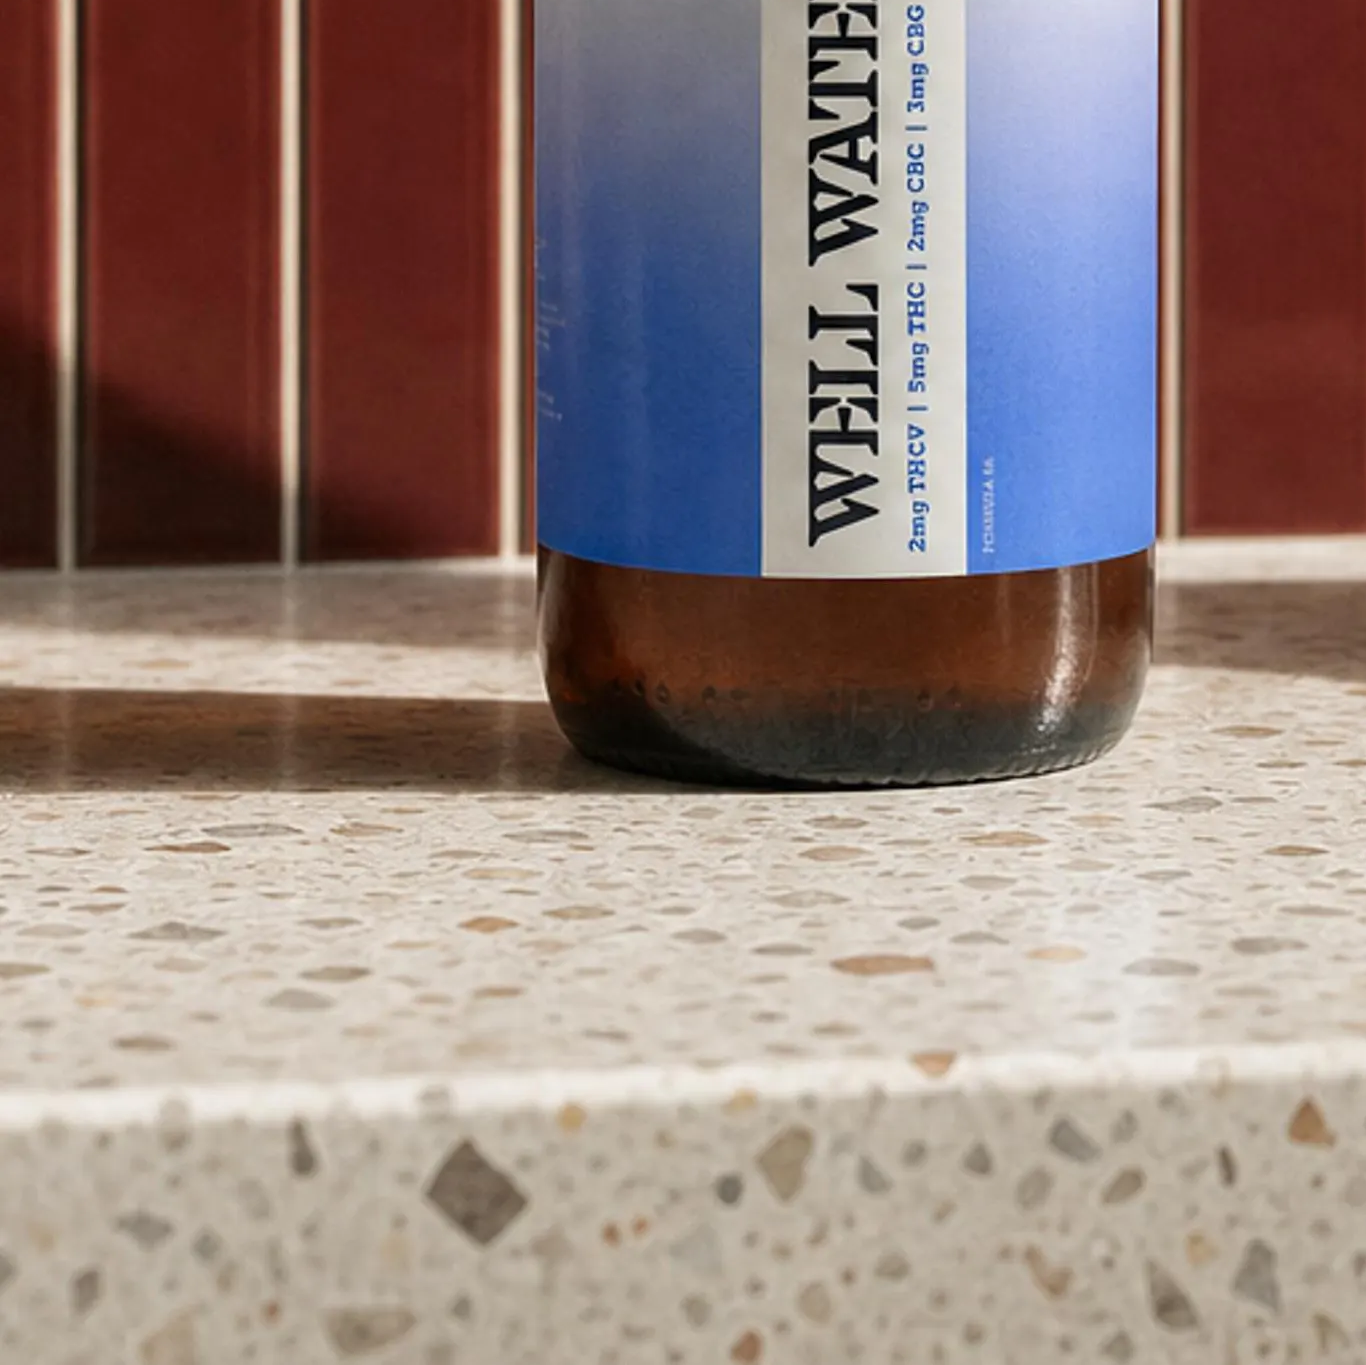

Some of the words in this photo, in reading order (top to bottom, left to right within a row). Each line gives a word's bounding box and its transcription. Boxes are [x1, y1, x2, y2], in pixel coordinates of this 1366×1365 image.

[906, 5, 926, 56] CBG
[907, 63, 928, 112] 3mg
[907, 144, 926, 192] CBC
[907, 201, 929, 251] 2mg
[907, 283, 926, 335] THC
[907, 342, 929, 392] 5mg
[807, 283, 880, 548] WELL
[907, 424, 926, 493] THCV
[908, 501, 930, 552] 2mg
